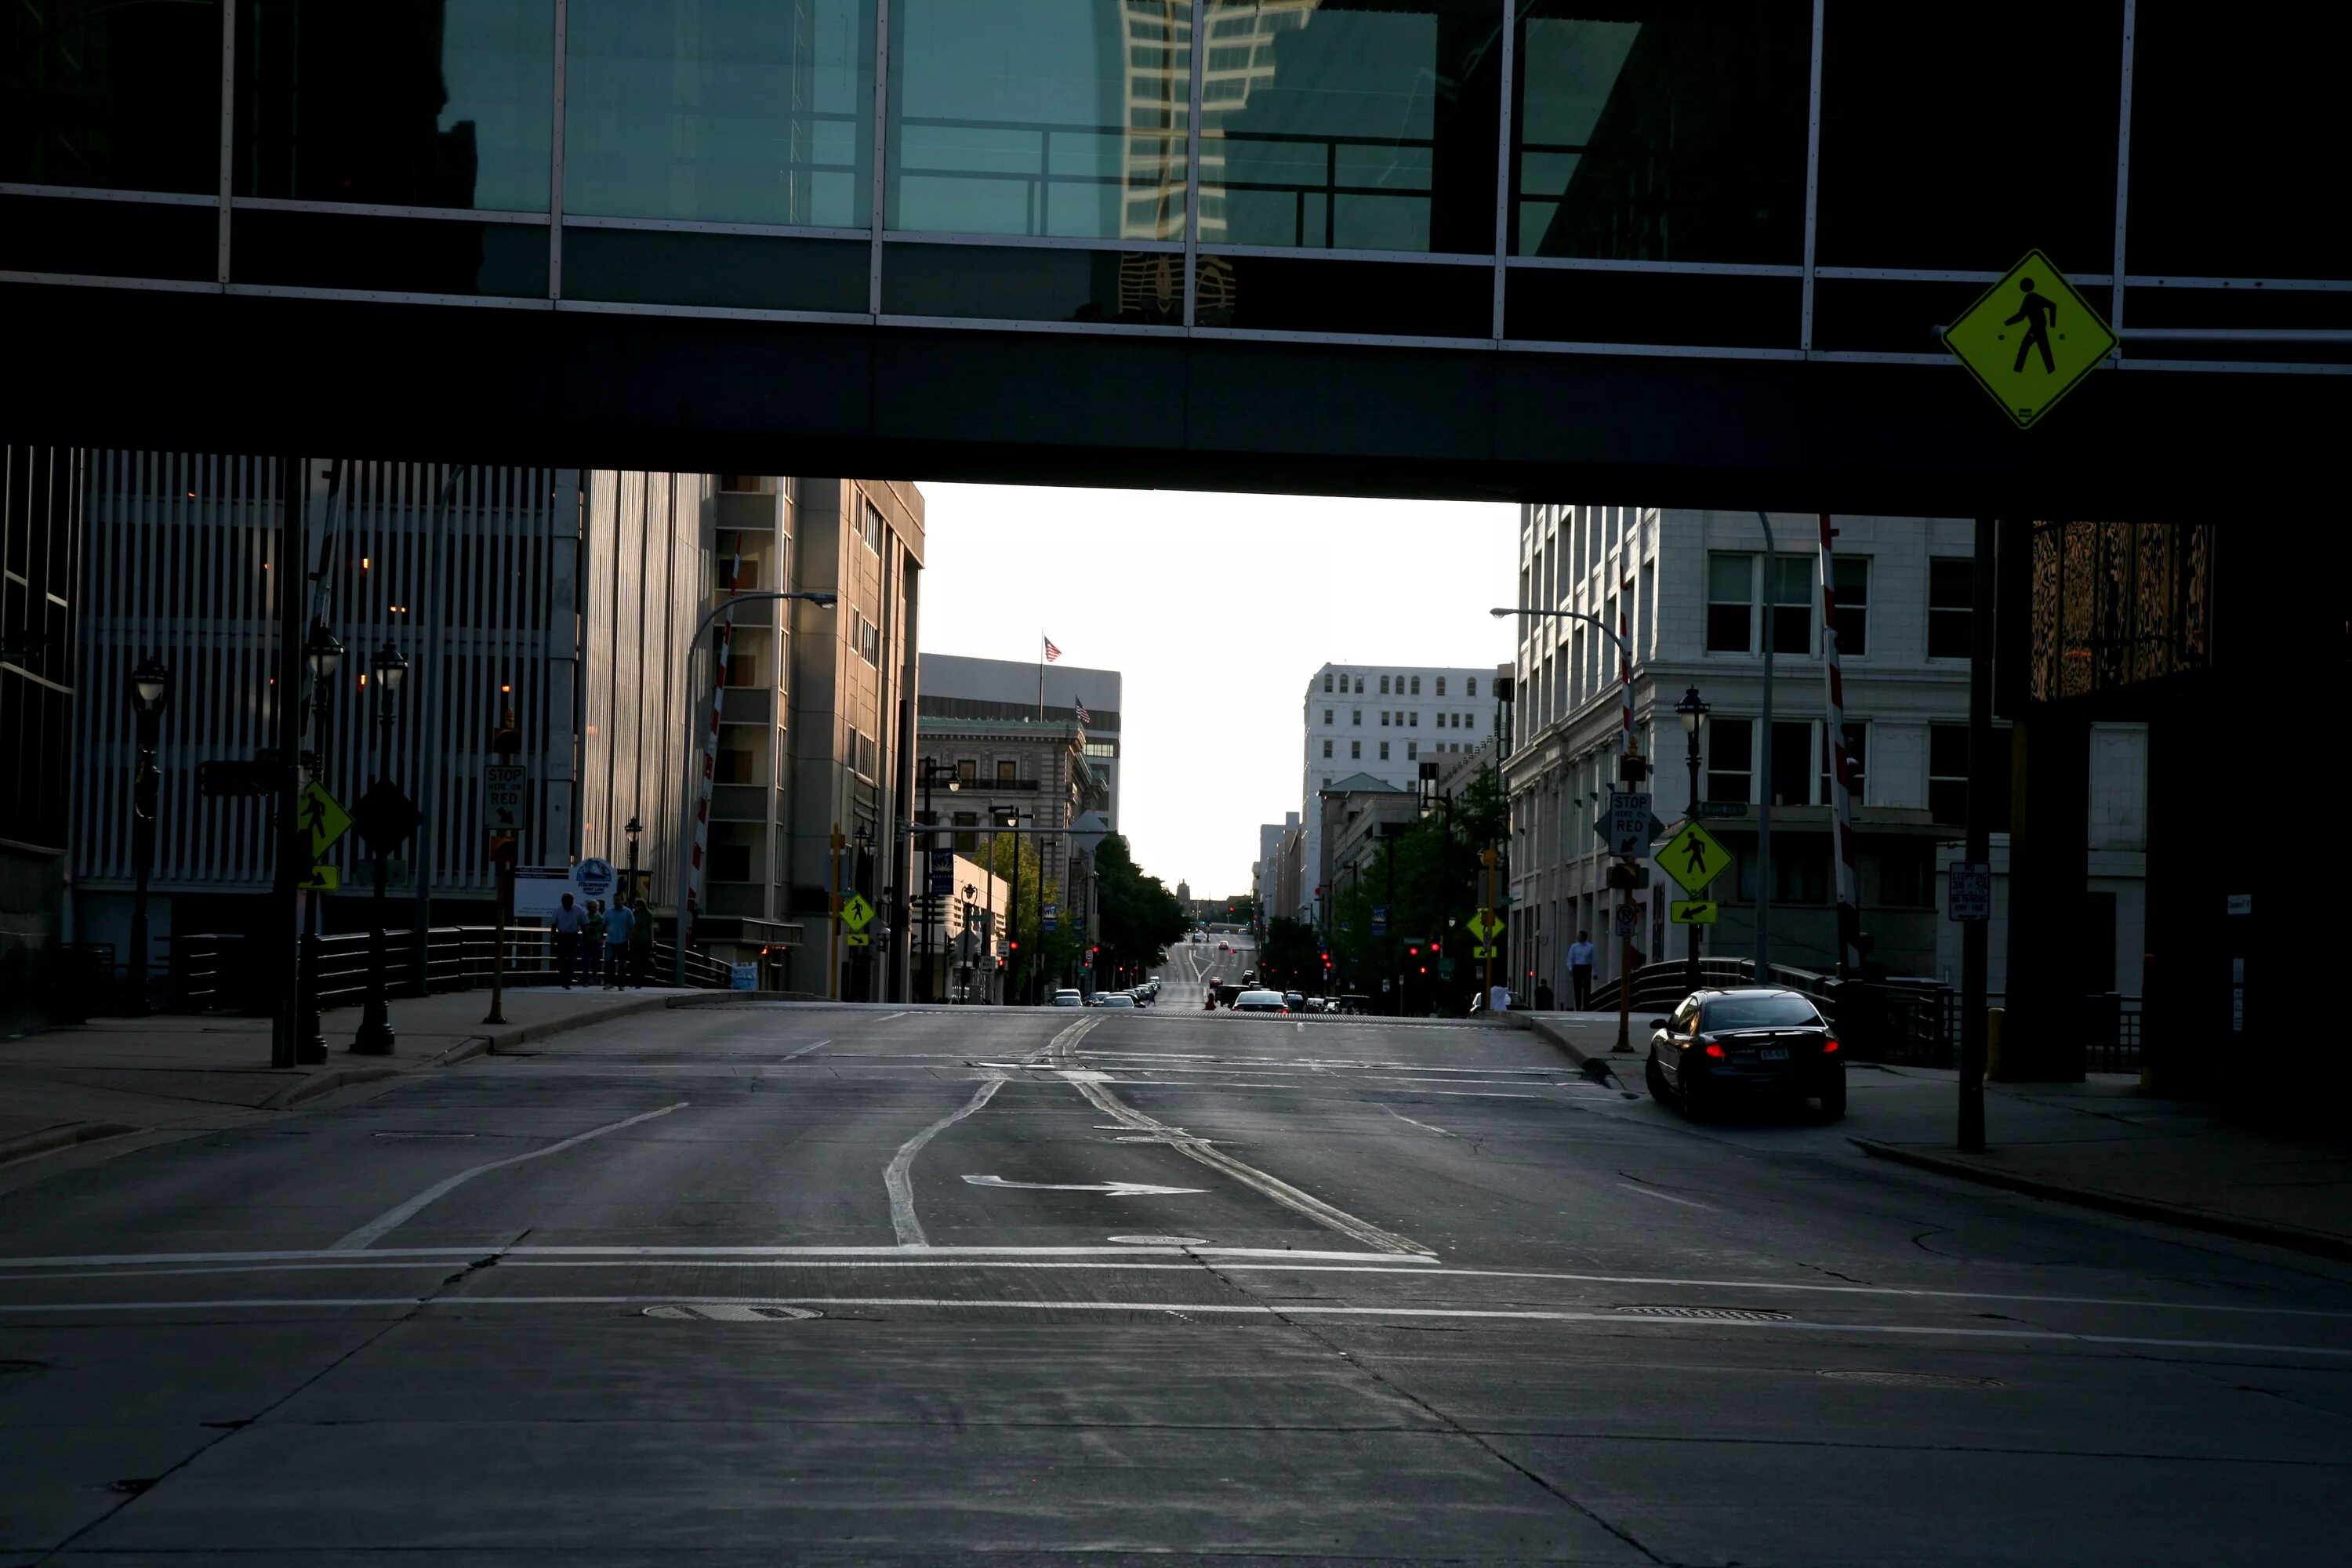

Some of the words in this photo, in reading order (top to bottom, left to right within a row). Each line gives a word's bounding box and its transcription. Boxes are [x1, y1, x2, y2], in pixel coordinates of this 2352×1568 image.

[489, 769, 521, 781] STOP
[492, 793, 517, 804] RED
[1615, 797, 1646, 808] STOP
[1617, 820, 1643, 832] RED
